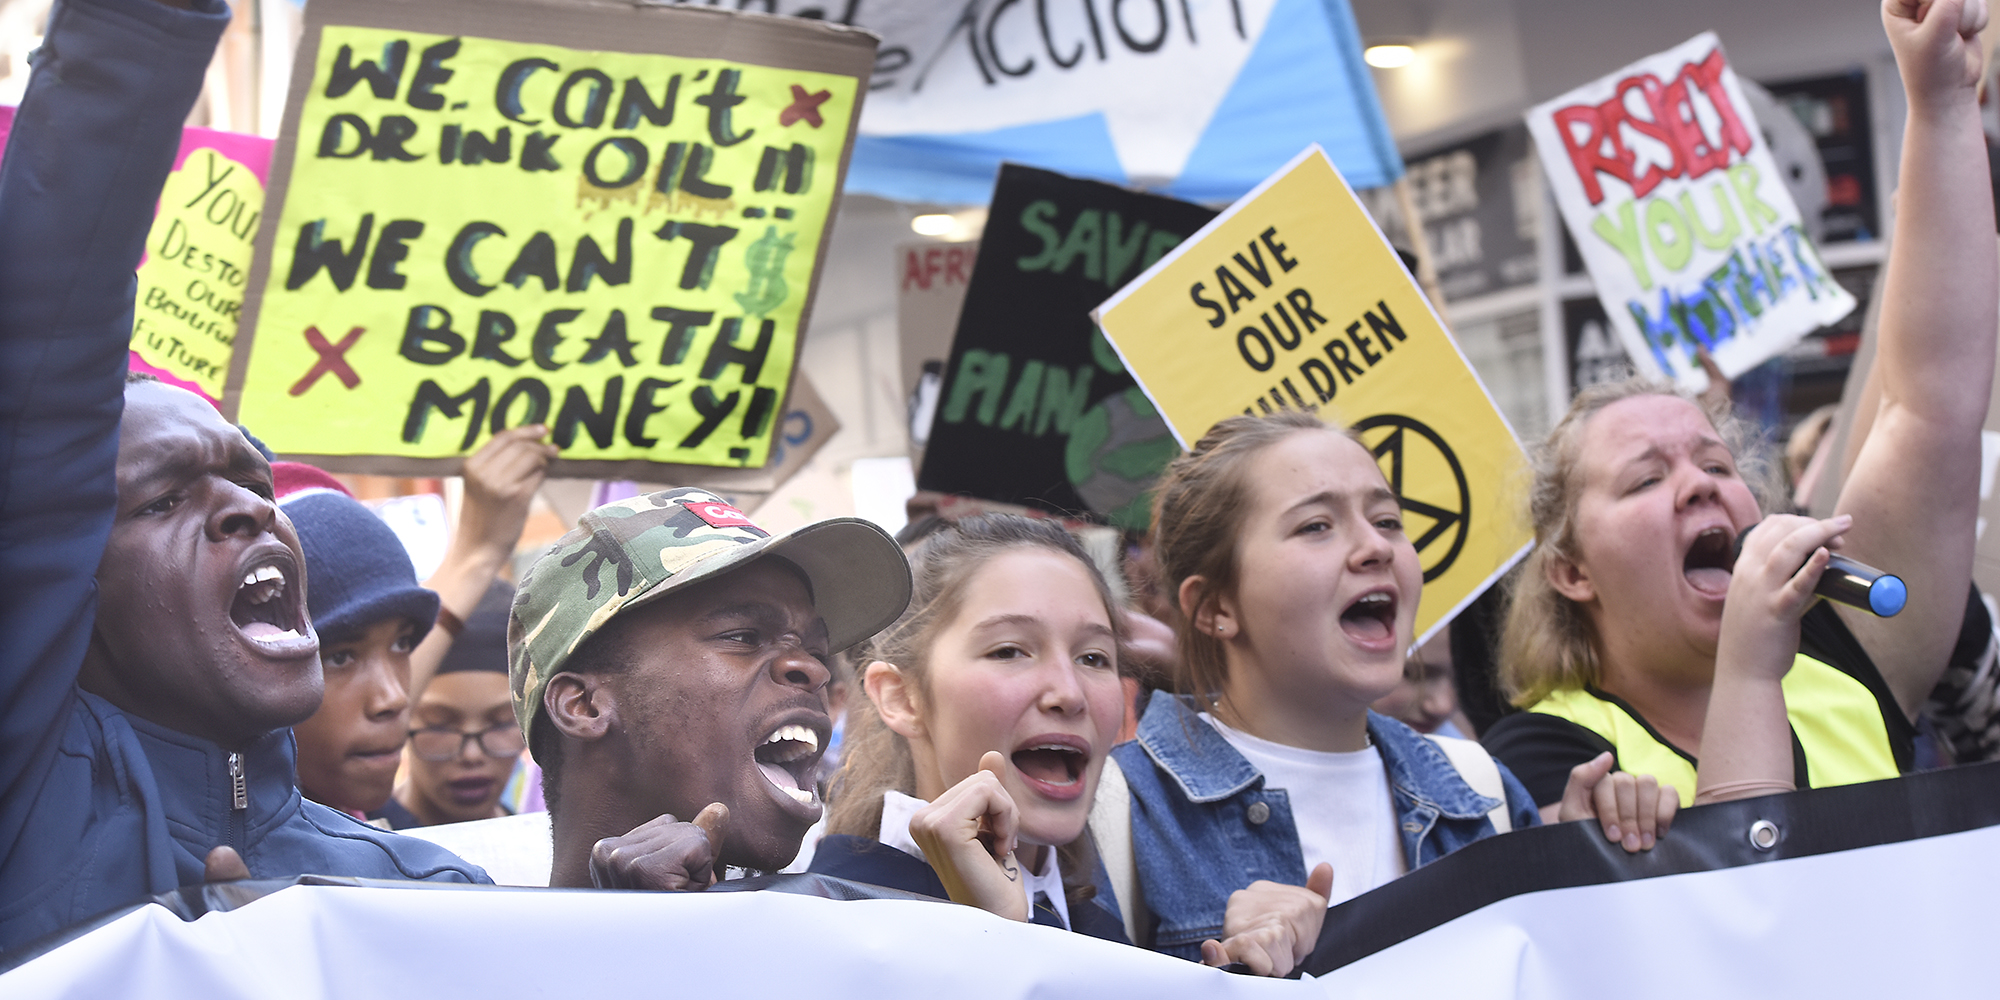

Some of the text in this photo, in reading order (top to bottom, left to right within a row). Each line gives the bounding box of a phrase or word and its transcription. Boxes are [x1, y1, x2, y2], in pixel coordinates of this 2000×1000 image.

[315, 113, 562, 172] DRINK
[582, 137, 734, 200] OIL
[285, 213, 426, 293] WE
[1591, 162, 1779, 291] YOUR
[1189, 226, 1299, 329] SAVE
[398, 304, 776, 386] BREATH
[1236, 287, 1328, 373] OUR
[1242, 299, 1408, 420] LDREN
